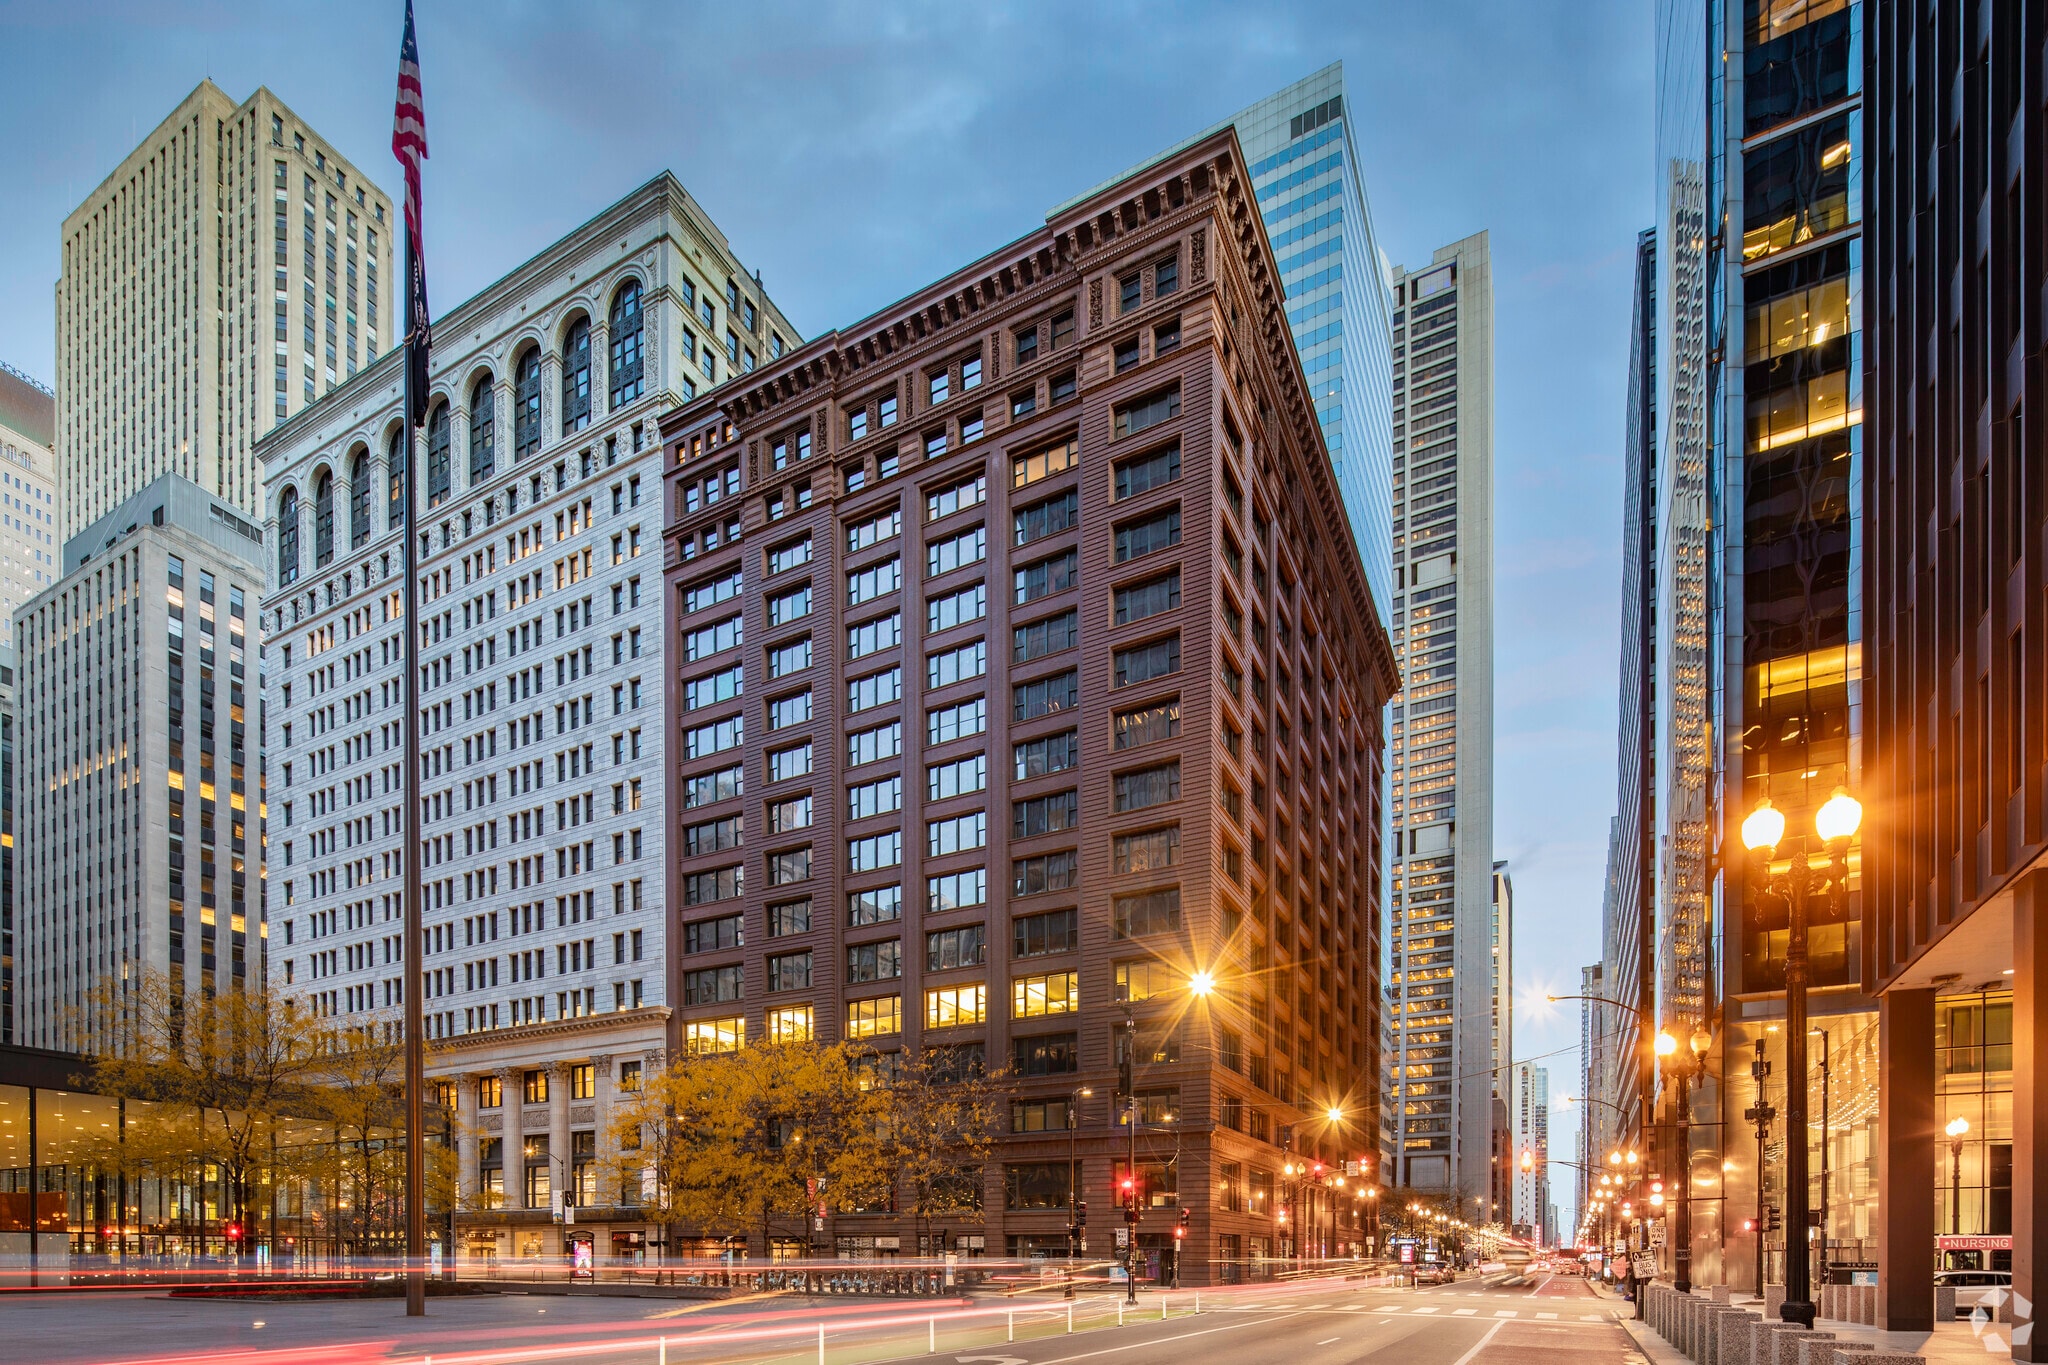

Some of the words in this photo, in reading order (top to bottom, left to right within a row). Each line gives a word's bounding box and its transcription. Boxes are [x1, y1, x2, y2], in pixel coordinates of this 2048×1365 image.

[1950, 1239, 2009, 1248] NURSING
[1639, 1261, 1652, 1269] BUS
[1639, 1268, 1655, 1276] ONLY
